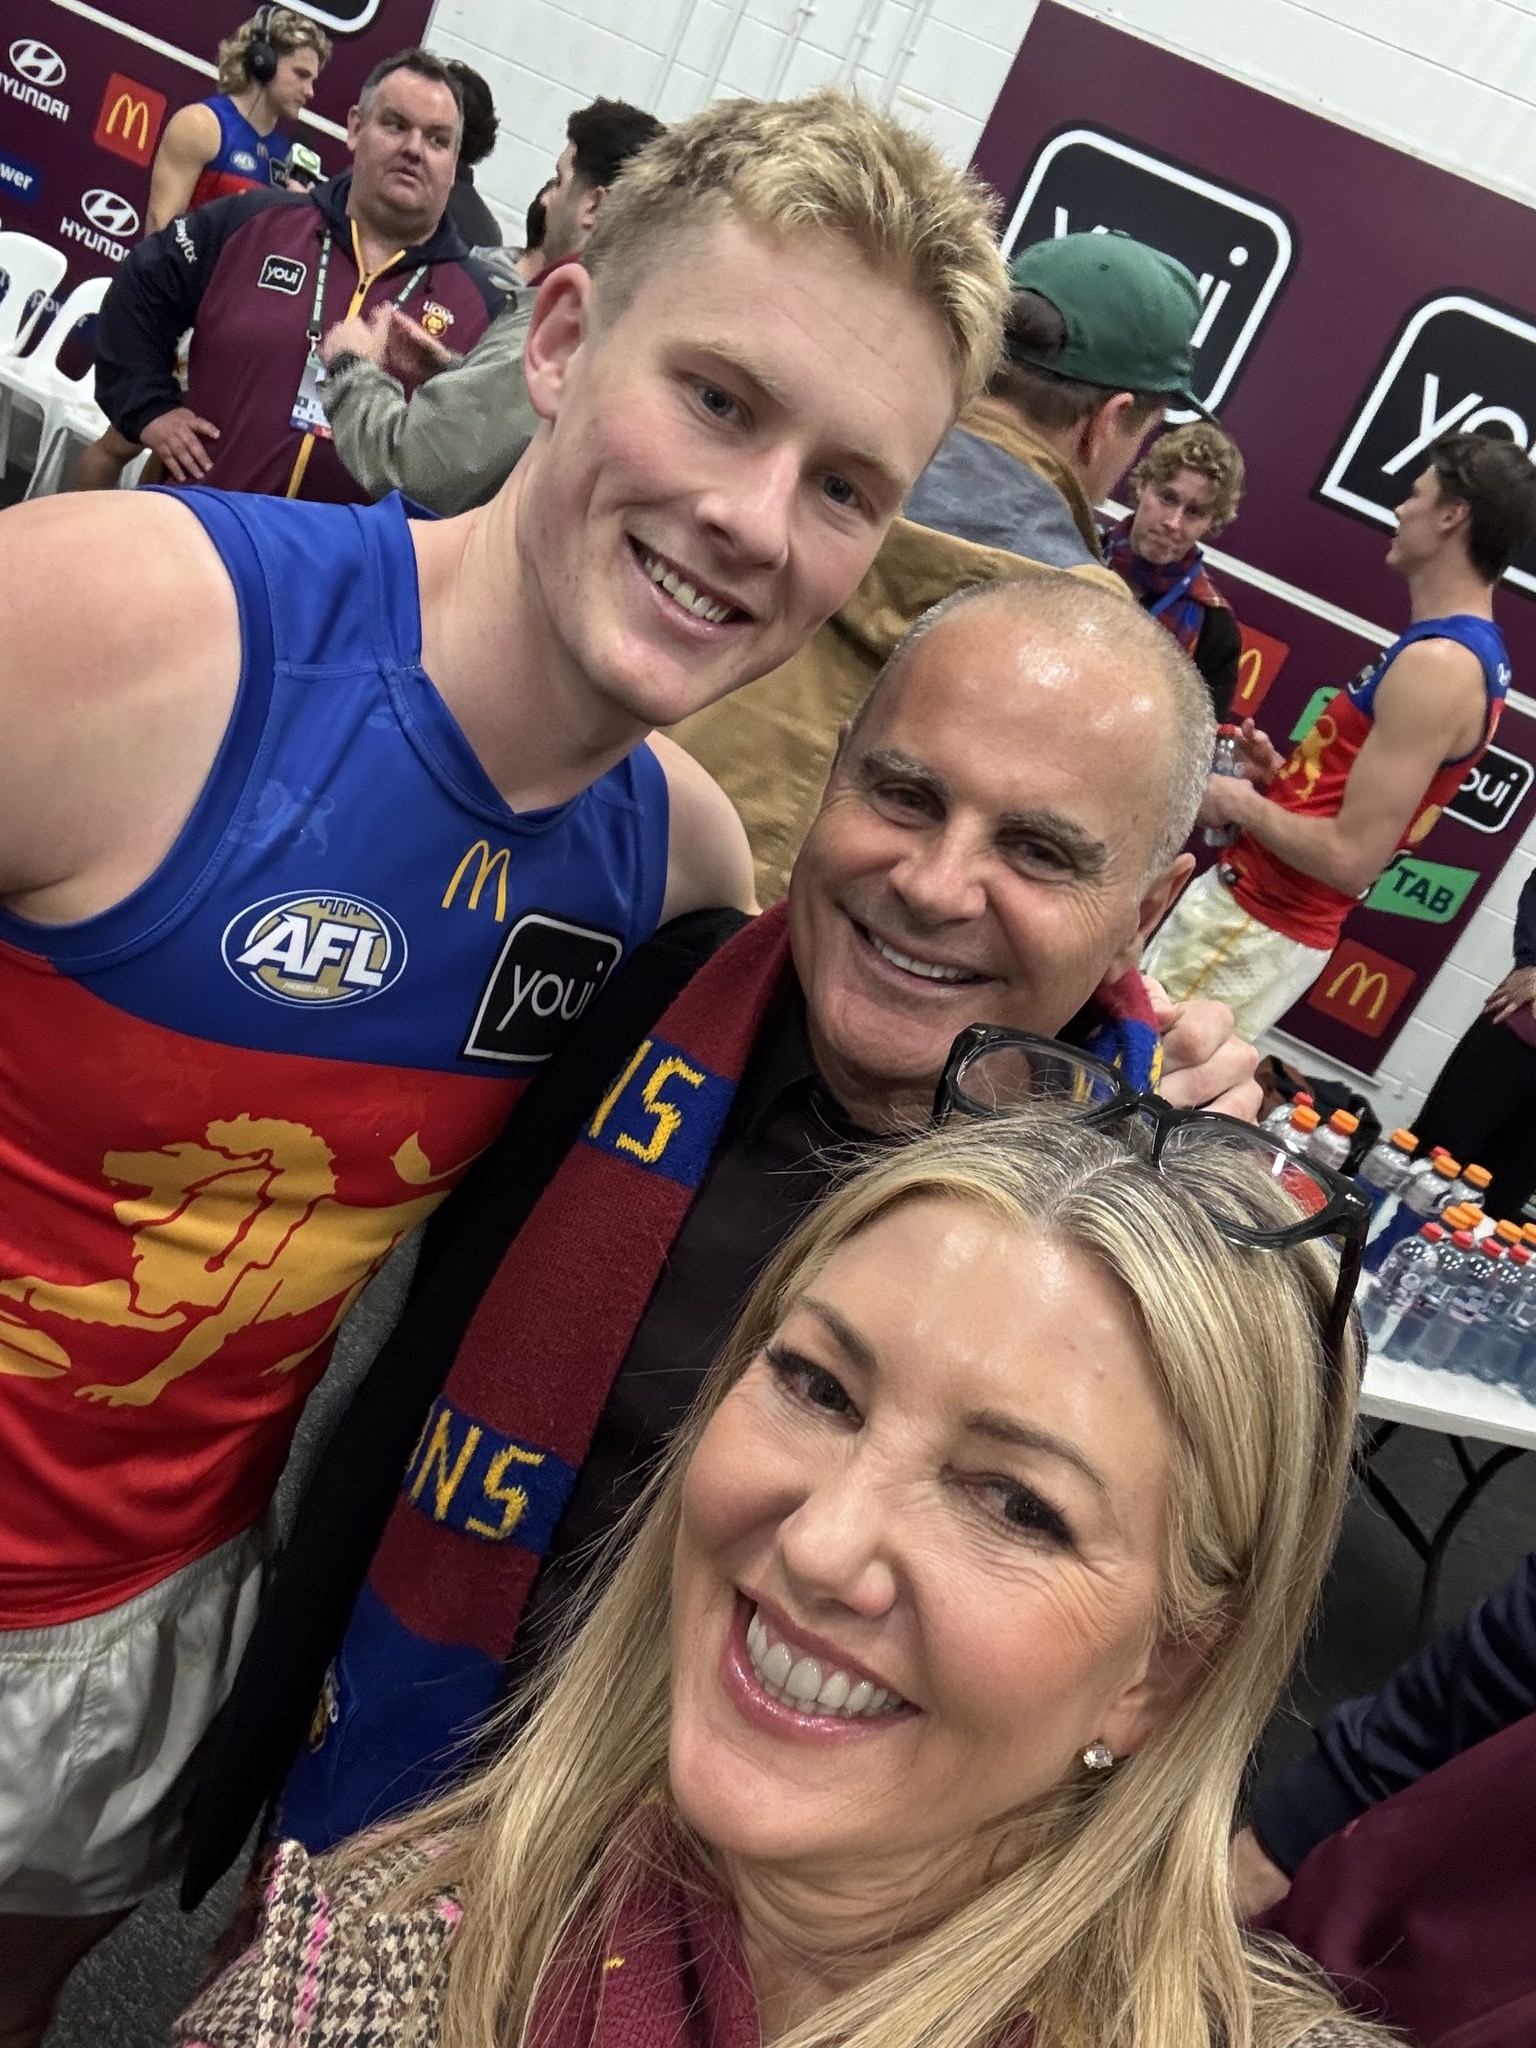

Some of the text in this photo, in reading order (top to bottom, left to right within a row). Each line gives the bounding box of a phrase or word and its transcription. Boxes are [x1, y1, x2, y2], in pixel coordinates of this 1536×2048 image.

[60, 216, 130, 262] HYUND
[265, 265, 300, 284] youi
[1459, 767, 1519, 808] oui
[1393, 866, 1454, 914] TAB
[236, 913, 384, 987] AFL
[496, 960, 604, 1032] youi
[405, 1405, 546, 1540] NS
